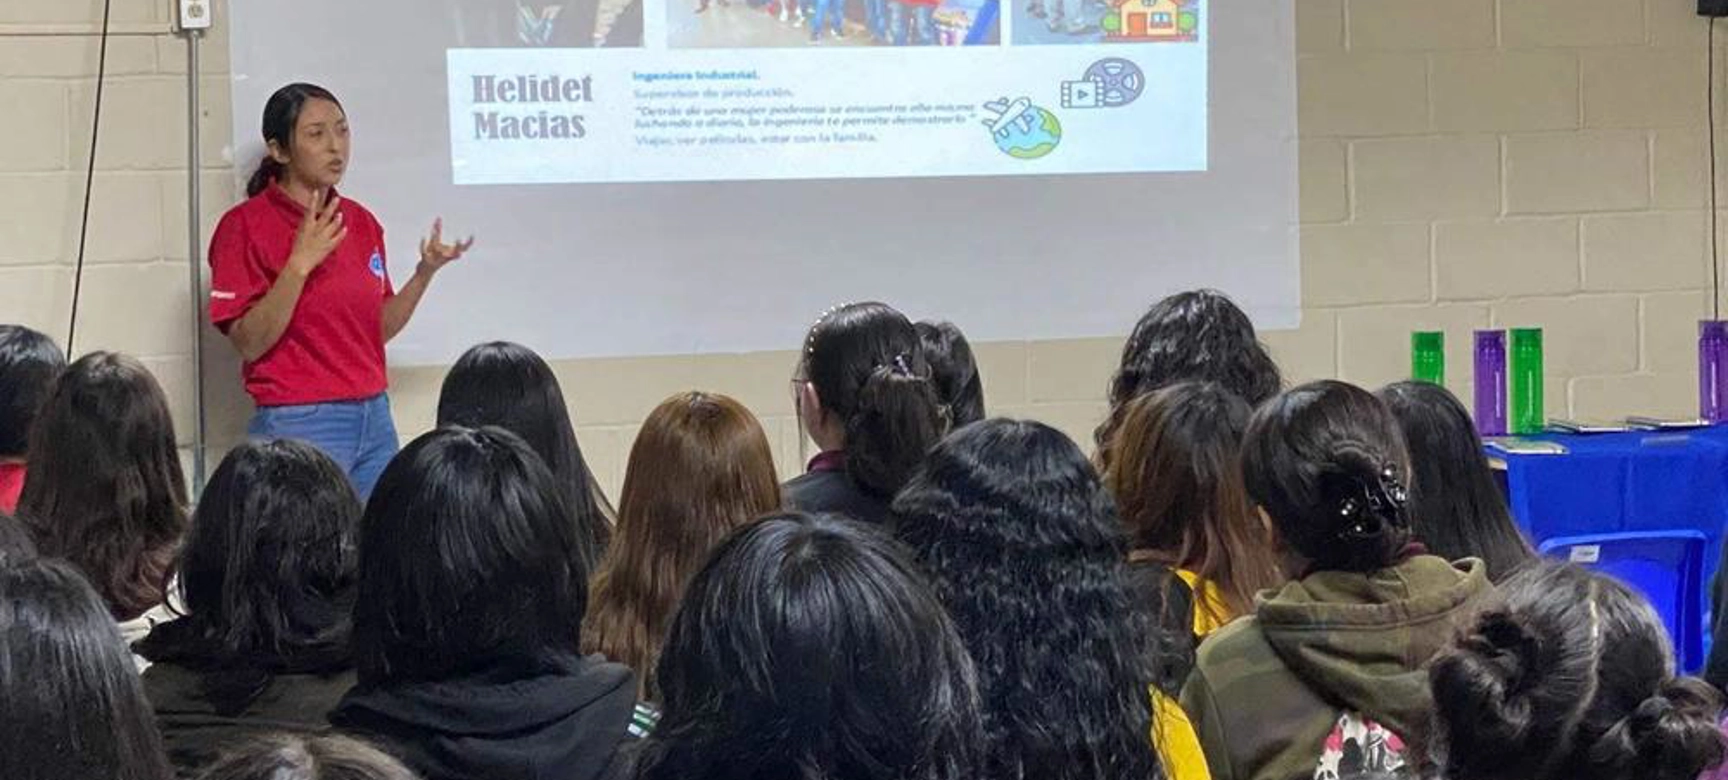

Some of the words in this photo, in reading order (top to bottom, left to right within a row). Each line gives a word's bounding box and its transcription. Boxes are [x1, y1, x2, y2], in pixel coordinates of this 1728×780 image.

[471, 74, 593, 103] Helidet
[702, 88, 718, 98] de
[685, 105, 701, 116] de
[704, 107, 727, 116] una
[730, 106, 766, 118] mujer
[769, 104, 826, 116] poderosa
[829, 105, 843, 114] se
[473, 110, 586, 140] Macias
[748, 117, 760, 126] la
[827, 116, 840, 125] te
[842, 115, 890, 127] permite
[793, 135, 816, 144] con
[818, 133, 831, 143] la
